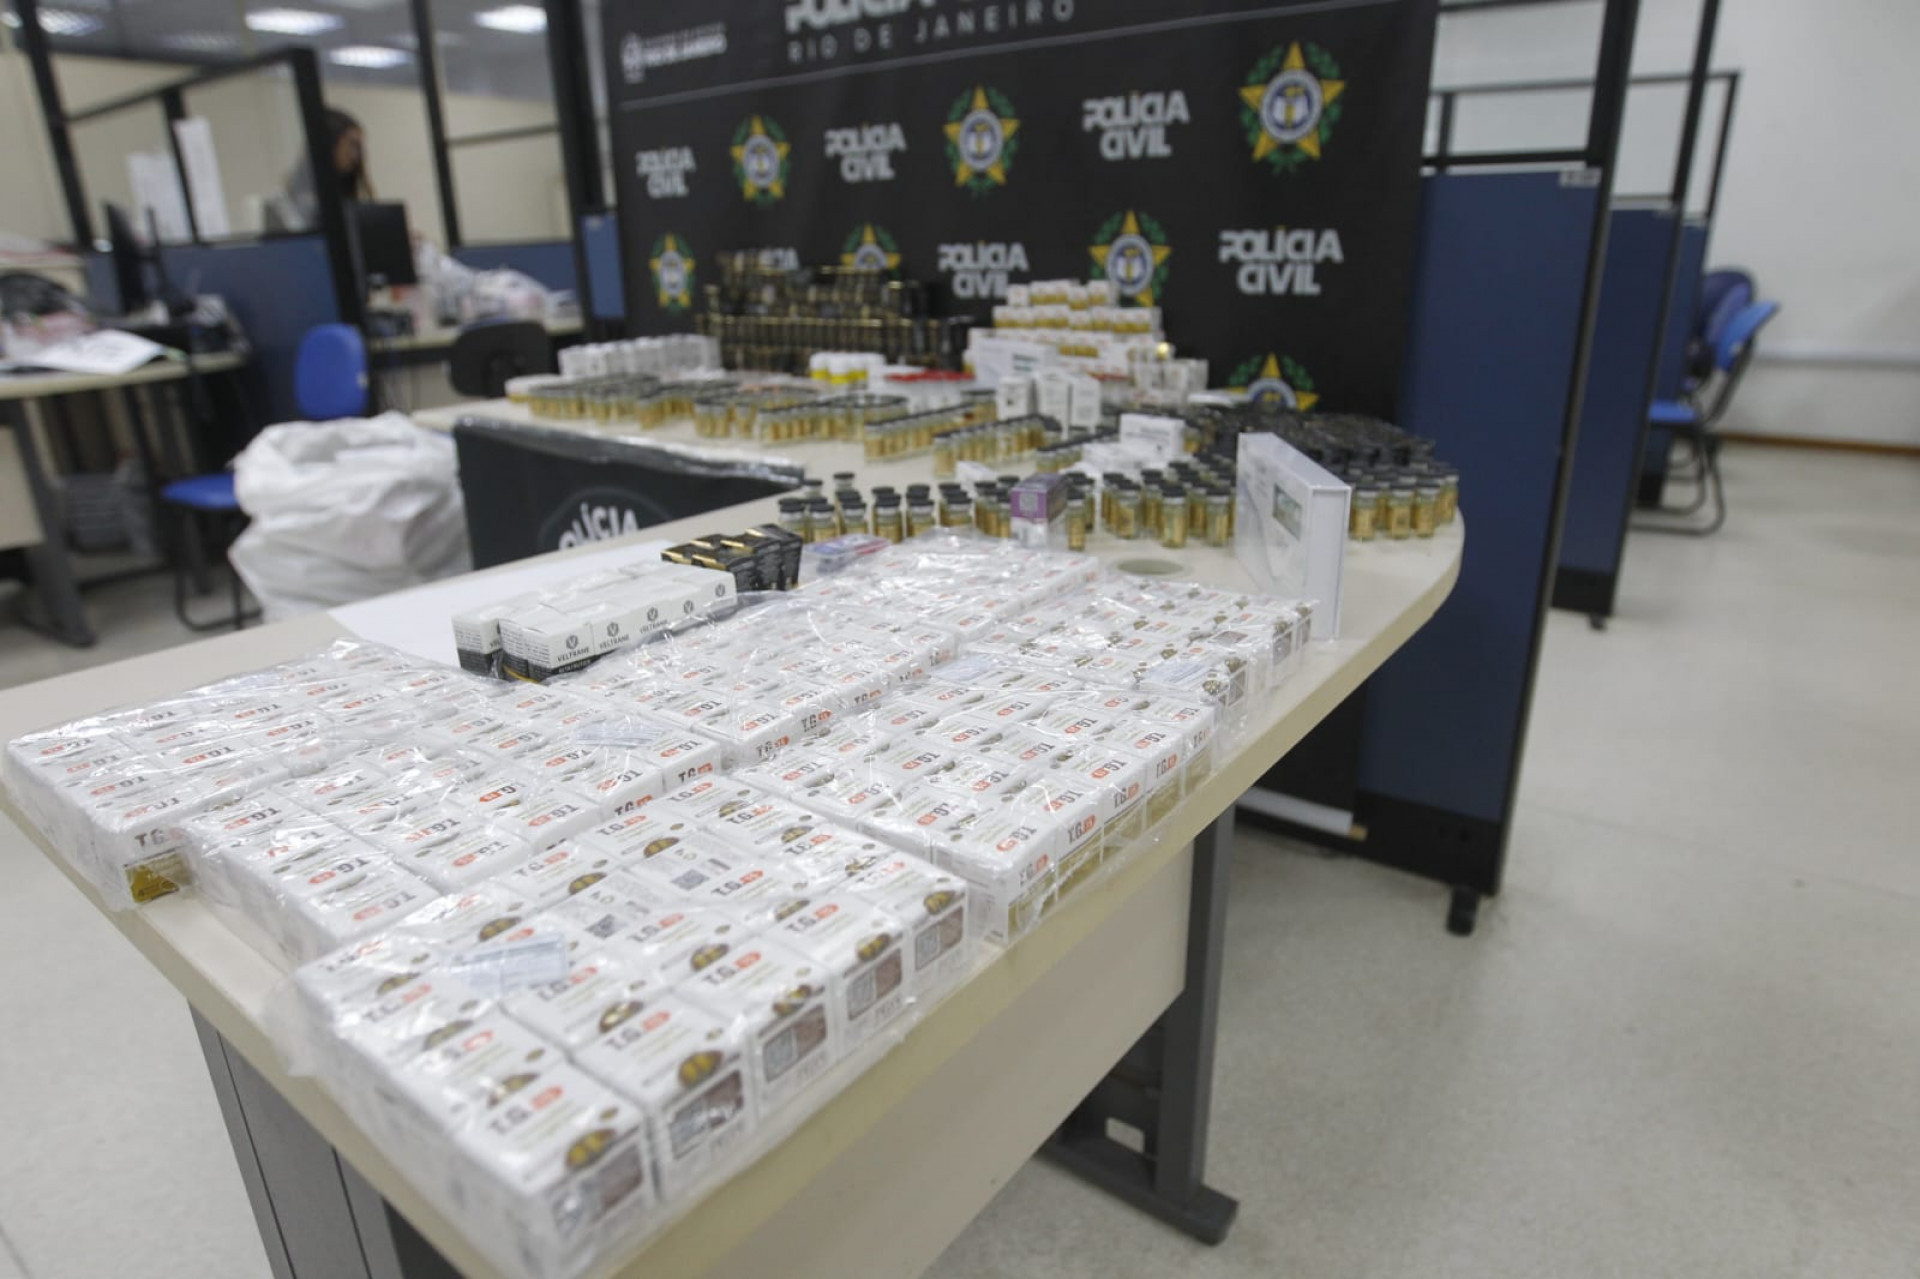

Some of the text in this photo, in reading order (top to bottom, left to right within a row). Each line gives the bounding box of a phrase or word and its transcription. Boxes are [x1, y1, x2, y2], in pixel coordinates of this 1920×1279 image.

[788, 0, 1073, 62] RIO DE JANEIRO
[1101, 125, 1171, 160] CIVIL
[1218, 226, 1344, 263] POLÍCIA
[1237, 261, 1321, 294] CIVIL
[557, 647, 590, 663] VELTRANE
